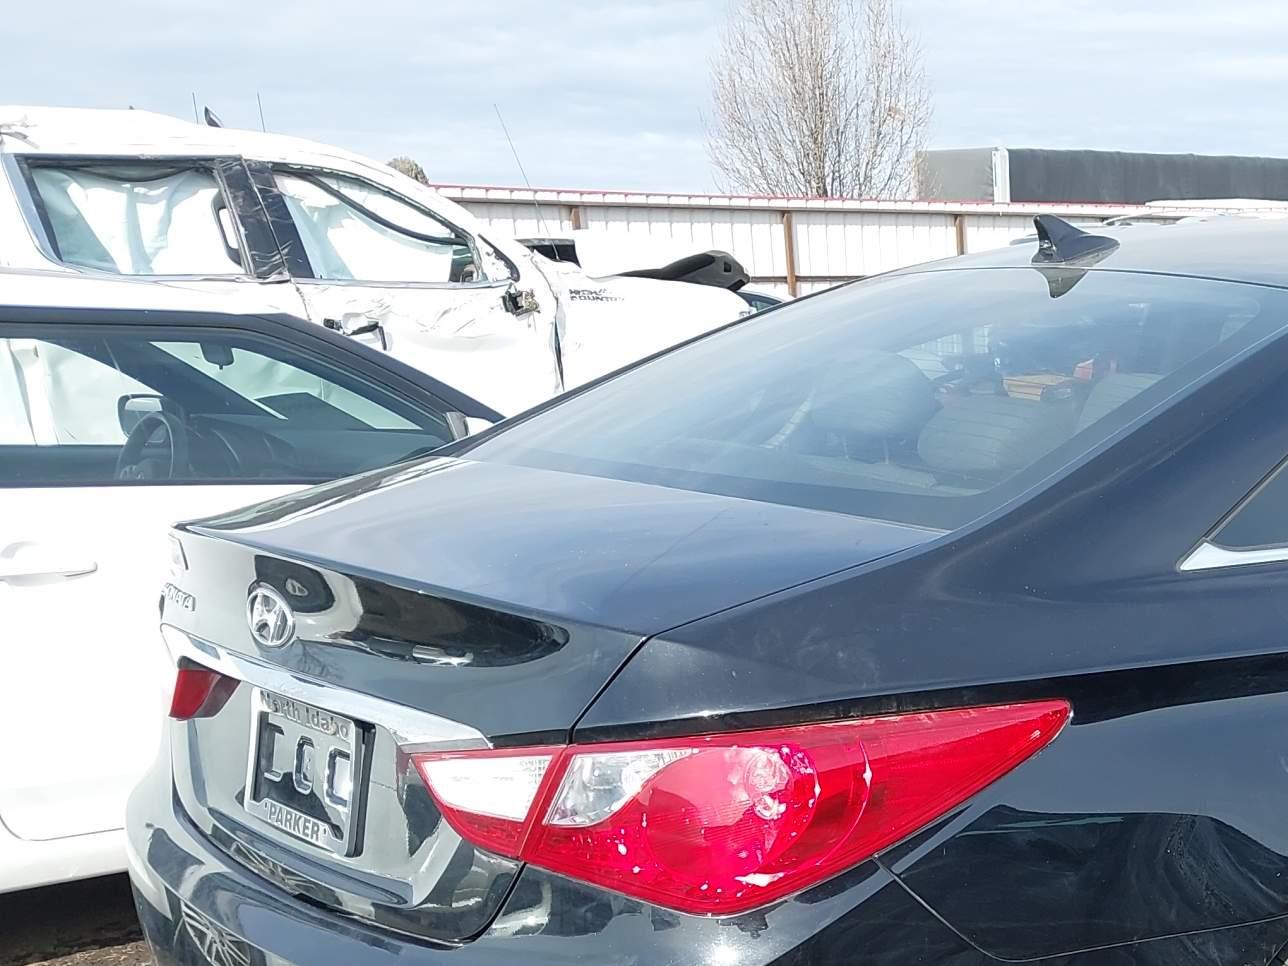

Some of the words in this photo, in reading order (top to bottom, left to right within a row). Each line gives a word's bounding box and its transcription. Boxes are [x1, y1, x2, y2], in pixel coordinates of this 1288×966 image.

[260, 690, 301, 723] North
[304, 706, 349, 740] Idaho
[269, 802, 319, 842] PARKER
